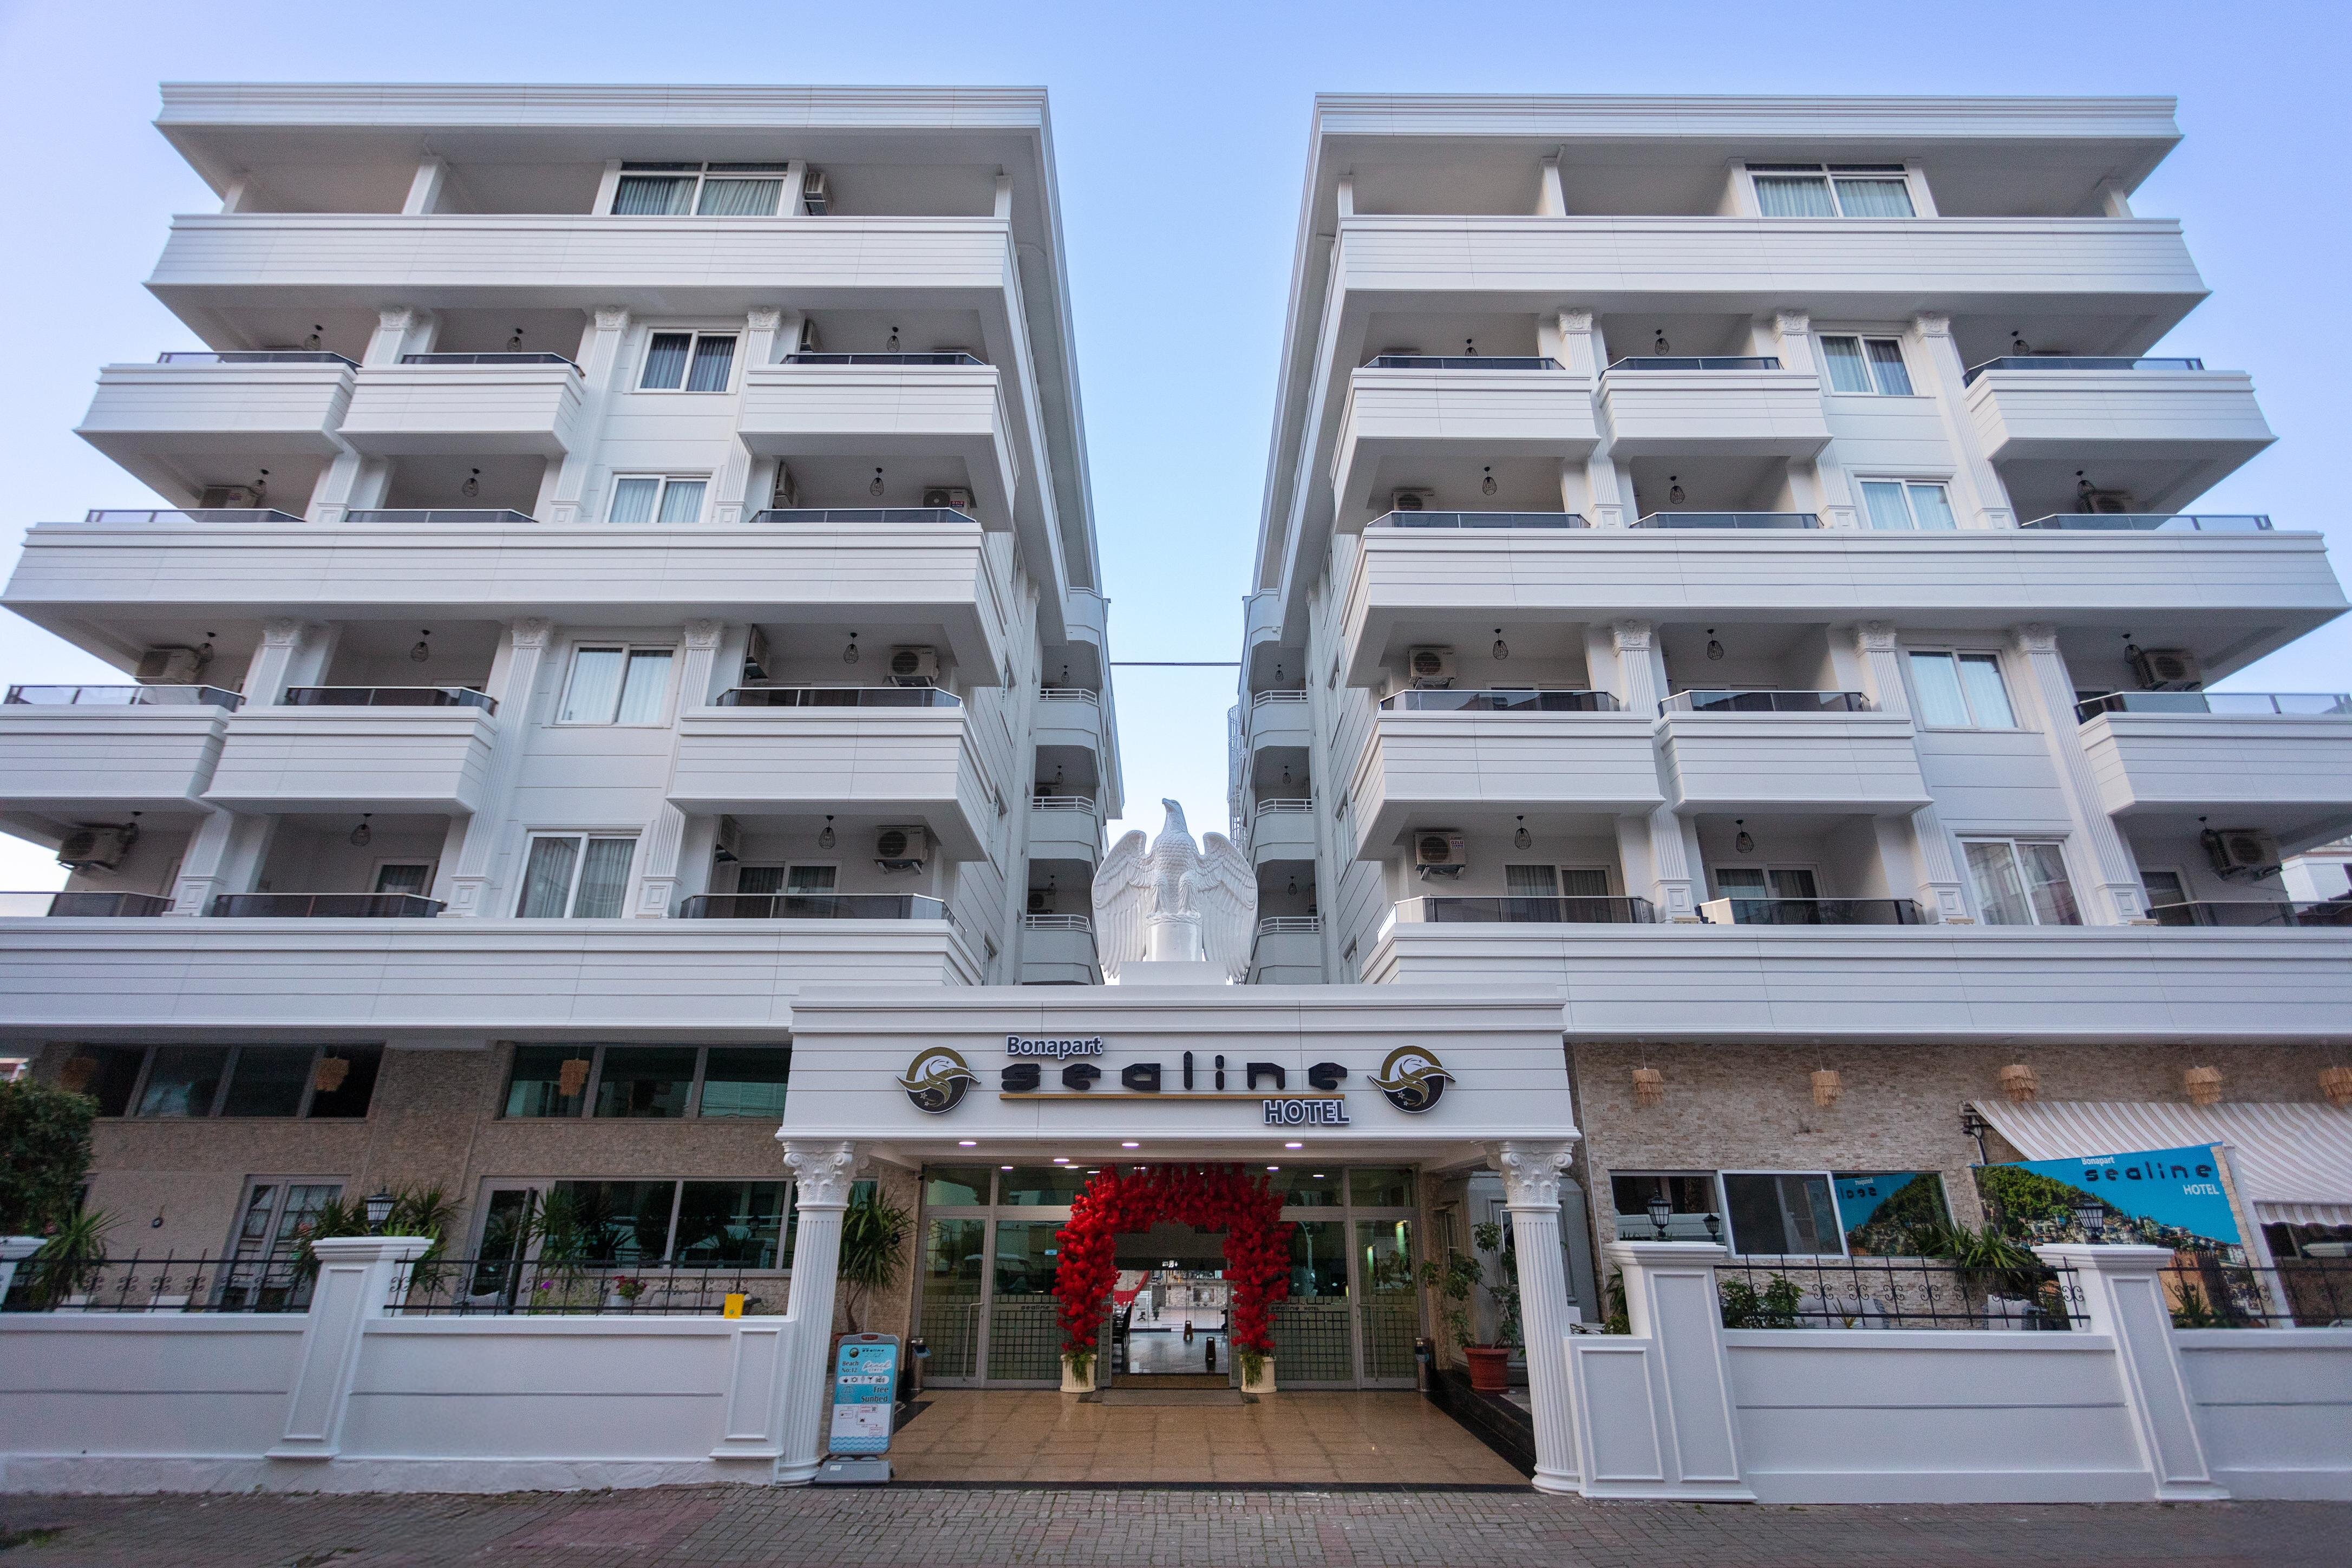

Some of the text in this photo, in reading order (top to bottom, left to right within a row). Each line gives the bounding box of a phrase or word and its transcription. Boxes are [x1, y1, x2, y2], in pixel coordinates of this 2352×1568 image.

[1005, 1035, 1103, 1060] Bonapart
[1001, 1050, 1348, 1091] sealine
[1263, 1100, 1351, 1125] HOTEL
[2081, 1156, 2115, 1166] Bonapart
[2084, 1161, 2212, 1182] sealine
[2183, 1184, 2219, 1195] HOTEL
